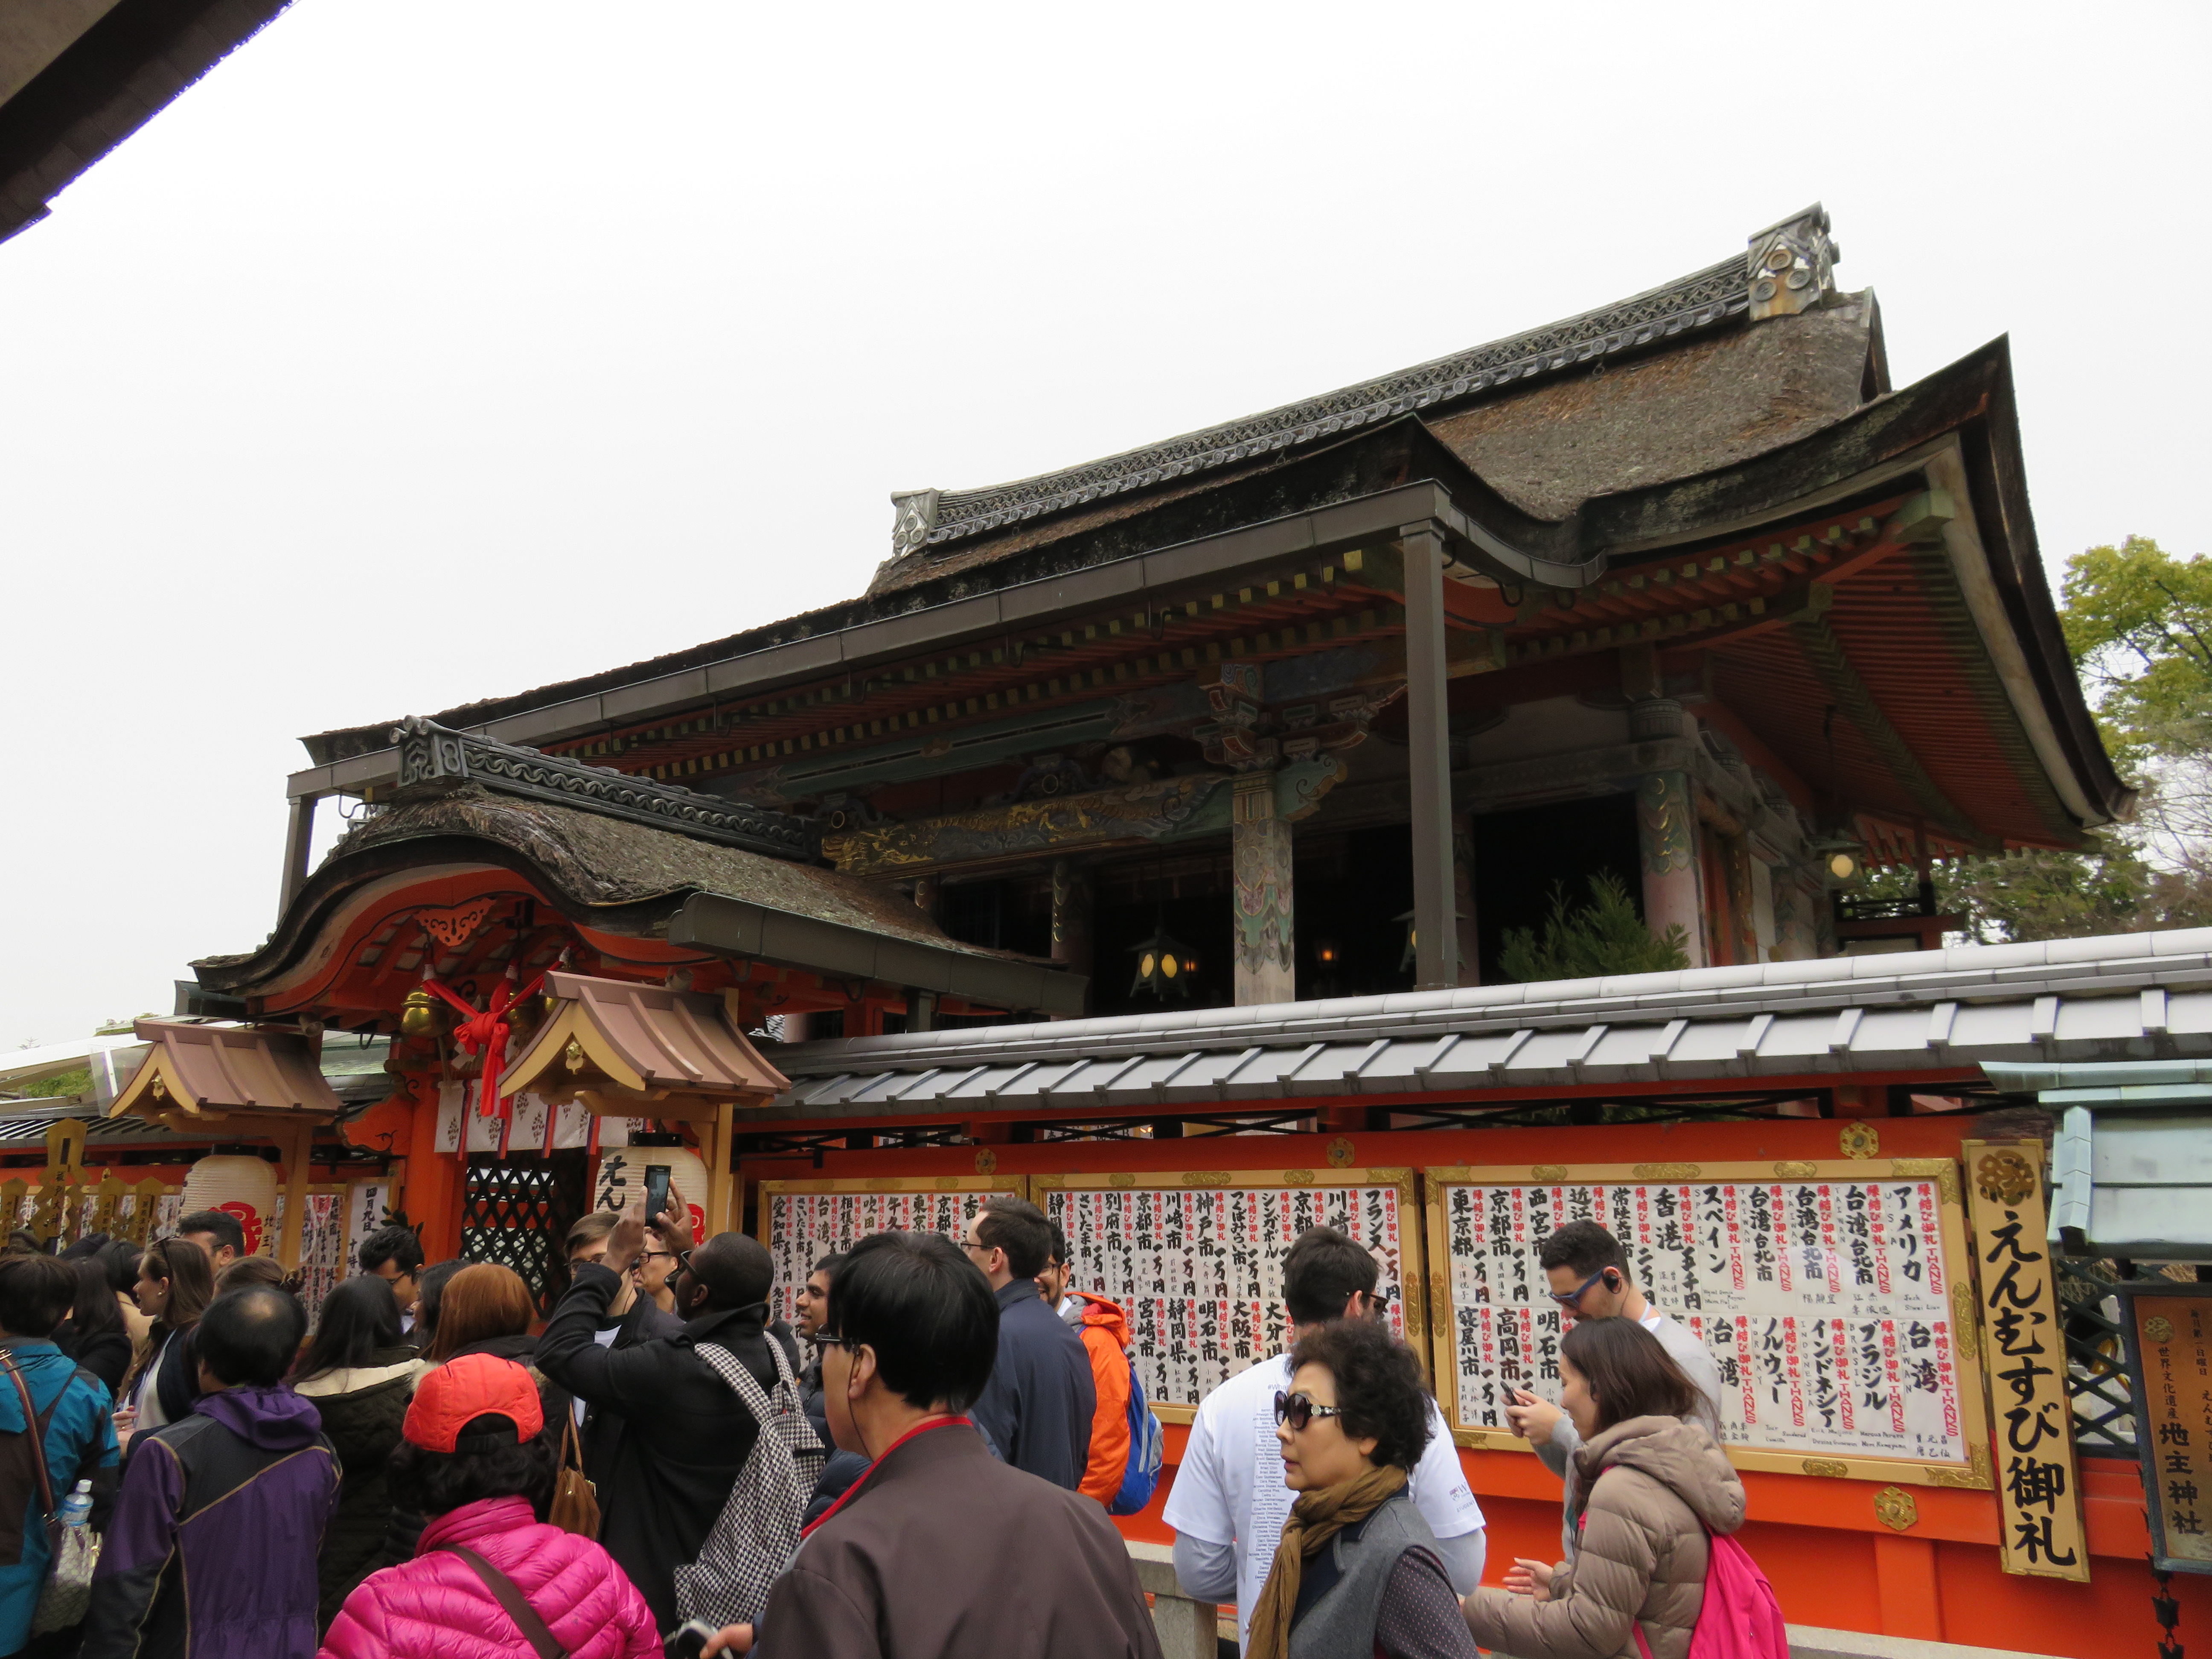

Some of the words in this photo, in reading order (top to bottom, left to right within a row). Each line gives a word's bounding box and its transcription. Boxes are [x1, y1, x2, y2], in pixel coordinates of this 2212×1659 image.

[361, 1187, 377, 1231] 四月九日
[772, 1196, 786, 1251] 愛知県
[796, 1197, 807, 1253] さいたま市
[817, 1196, 830, 1244] 台湾
[840, 1196, 854, 1251] 相模原市
[1066, 1193, 1074, 1238] 縁結び御礼
[1079, 1193, 1093, 1258] さいたま市
[1094, 1193, 1103, 1240] 縁結び御礼
[1104, 1192, 1122, 1252] 別府市
[1123, 1193, 1132, 1240] 縁結び御礼
[1134, 1192, 1153, 1251] 京都市
[1153, 1192, 1163, 1240] 縁結び御礼
[1165, 1192, 1183, 1249] 川崎市
[1184, 1193, 1193, 1241] 縁結び御礼
[1195, 1192, 1214, 1257] 神戸市
[1215, 1191, 1225, 1241] 縁結び御礼
[1231, 1191, 1247, 1266] つくばみらい市
[1247, 1193, 1258, 1242] 縁結び御礼
[1262, 1193, 1280, 1259] シンガポール
[1280, 1191, 1291, 1242] 縁結び御礼
[1349, 1189, 1361, 1242] 縁結び御礼
[1365, 1189, 1386, 1252] フランス
[1385, 1189, 1397, 1242] 縁結び御礼
[1451, 1188, 1474, 1257] 東京都
[1473, 1189, 1485, 1243] 縁結び御礼
[1489, 1188, 1511, 1257] 京都市
[1511, 1188, 1525, 1243] 縁結び御礼
[1635, 1186, 1651, 1244] 縁結び御礼
[1654, 1187, 1684, 1251] 香港
[1679, 1186, 1695, 1244] 縁結び御礼
[1695, 1189, 1705, 1246] SPAIN
[1703, 1186, 1726, 1273] スペイン
[1723, 1185, 1741, 1244] 縁結び御礼
[1740, 1190, 1750, 1244] TAIWAN
[1749, 1185, 1775, 1281] 台湾台北市
[1770, 1185, 1787, 1245] 縁結び御礼
[1787, 1190, 1798, 1247] TAIWAN
[1796, 1185, 1823, 1280] 台湾台北市
[1818, 1185, 1836, 1245] 縁結び御礼
[1835, 1187, 1846, 1243] TAIWAN
[1845, 1184, 1874, 1286] 台湾台北市
[1866, 1184, 1886, 1245] 縁結び御礼
[1893, 1185, 1921, 1282] アメリカ
[1917, 1183, 1938, 1245] 縁結び御礼
[783, 1241, 792, 1282] 五千円
[1092, 1245, 1105, 1292] 一万円
[1122, 1245, 1134, 1294] 一万円
[1153, 1243, 1165, 1294] 一万円
[1183, 1246, 1196, 1296] 一万円
[1213, 1247, 1228, 1298] 一万円
[1247, 1249, 1261, 1298] 一万円
[1385, 1248, 1401, 1300] 一万円
[1473, 1249, 1490, 1303] 一万円
[1512, 1248, 1529, 1302] 一万円
[1681, 1246, 1702, 1310] 五千円
[1730, 1247, 1745, 1290] THANKS
[1776, 1247, 1792, 1292] THANKS
[1825, 1247, 1841, 1293] THANKS
[1875, 1248, 1892, 1294] THANKS
[1926, 1247, 1943, 1295] THANKS
[1137, 1296, 1155, 1357] 宮崎市
[1156, 1298, 1166, 1347] 縁結び御礼
[1167, 1297, 1187, 1365] 静岡県
[1187, 1299, 1197, 1348] 縁結び御礼
[1199, 1300, 1218, 1362] 明石市
[1219, 1301, 1229, 1350] 縁結び御礼
[1230, 1299, 1252, 1359] 大阪市
[1251, 1301, 1263, 1351] 縁結び御礼
[1458, 1306, 1479, 1377] 寝屋川市
[1480, 1308, 1493, 1363] 縁結び御礼
[1496, 1307, 1520, 1381] 高岡市
[1519, 1308, 1533, 1364] 縁結び御礼
[1536, 1310, 1560, 1380] 明石市
[1735, 1315, 1751, 1375] 縁結び御礼
[1782, 1316, 1800, 1377] 縁結び御礼
[1831, 1318, 1851, 1380] 縁結び御礼
[1880, 1320, 1900, 1382] 縁結び御礼
[1155, 1351, 1169, 1401] 一万円
[1187, 1354, 1199, 1405] 一万円
[1713, 1317, 1740, 1388] 台湾
[1752, 1318, 1762, 1385] NORWAY
[1763, 1317, 1787, 1404] ノルウェー
[1801, 1320, 1813, 1407] INDONESIA
[1811, 1319, 1838, 1427] インドネシア
[1850, 1324, 1860, 1387] BRASIL
[1860, 1318, 1887, 1410] ブラジル
[1900, 1323, 1912, 1394] TAIWAN
[1908, 1321, 1938, 1394] 台湾
[1933, 1321, 1953, 1386] 縁結び御礼
[1481, 1369, 1497, 1427] 一万円
[1741, 1379, 1756, 1424] THANKS
[1790, 1380, 1805, 1427] THANKS
[1839, 1383, 1854, 1430] THANKS
[1889, 1385, 1905, 1432] THANKS
[1986, 1210, 2076, 1566] えんむすび御礼
[2158, 1346, 2180, 1419] 世界文化遺産
[1942, 1388, 1959, 1437] THANKS
[2159, 1423, 2205, 1536] 地主神社
